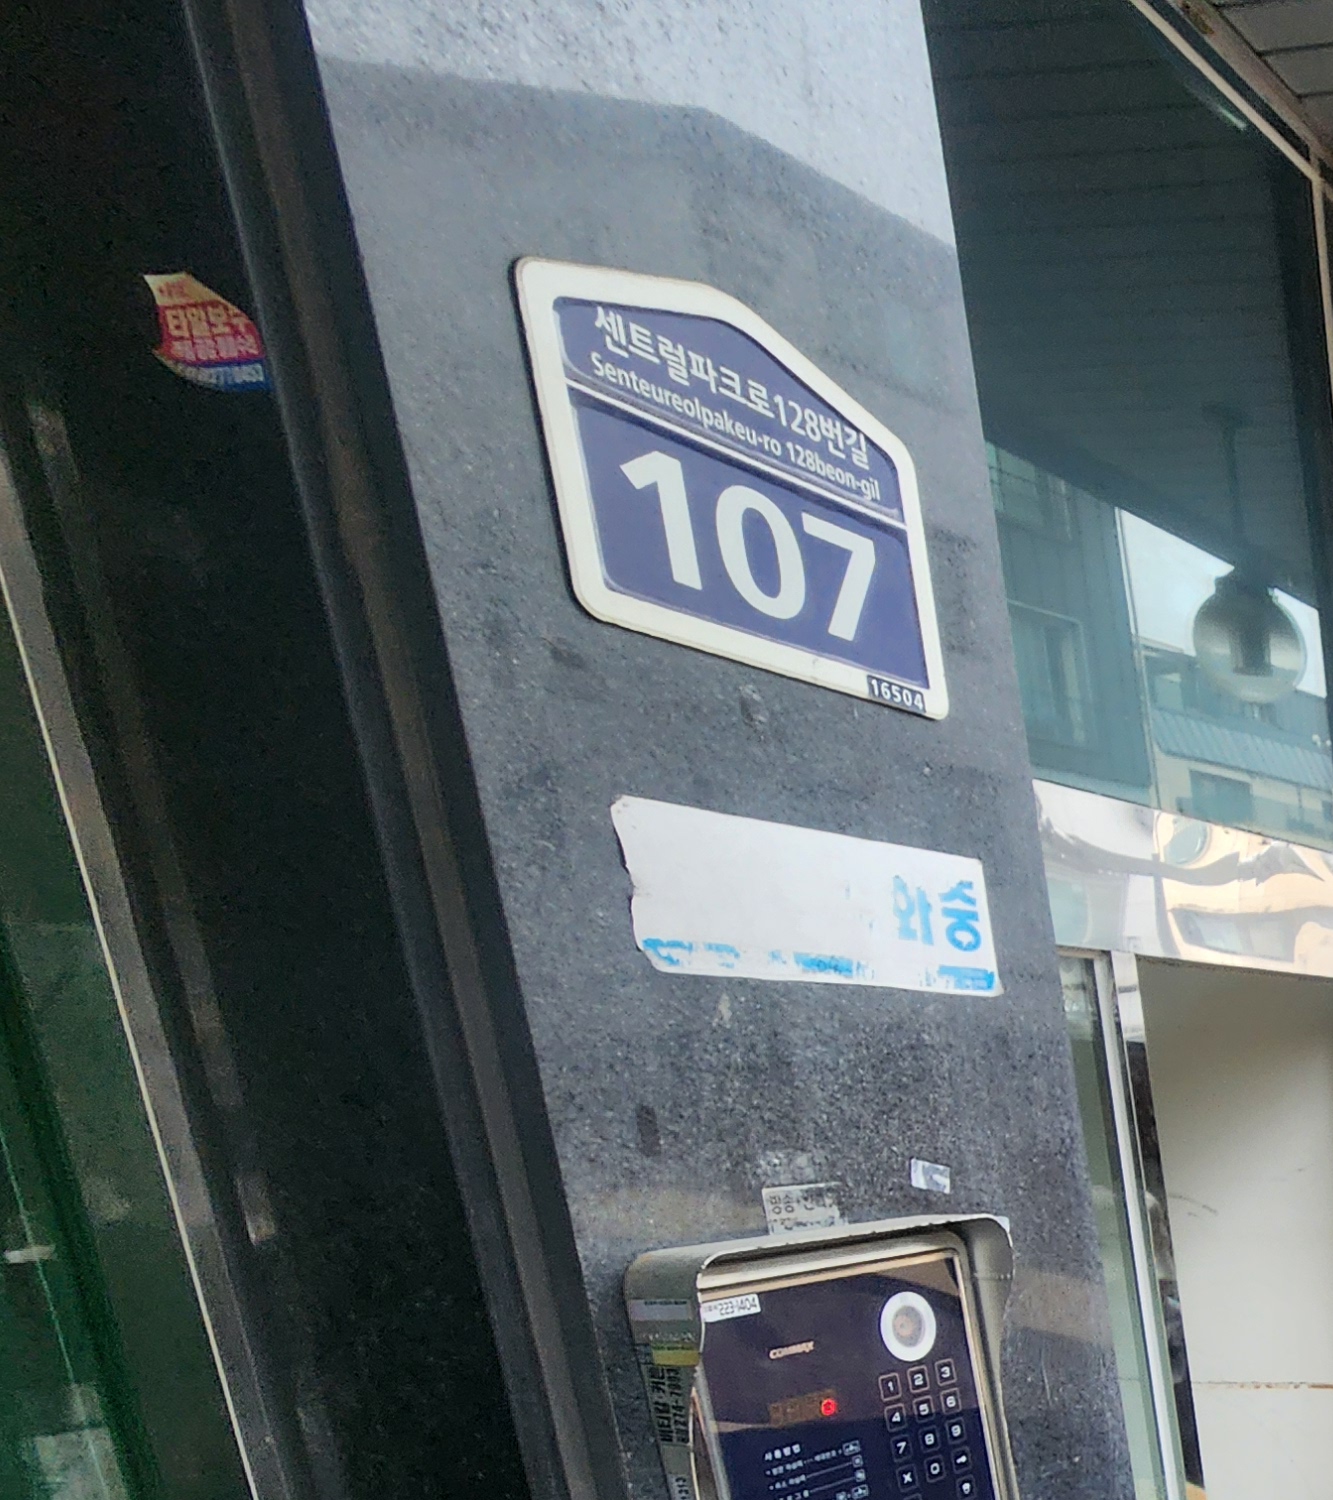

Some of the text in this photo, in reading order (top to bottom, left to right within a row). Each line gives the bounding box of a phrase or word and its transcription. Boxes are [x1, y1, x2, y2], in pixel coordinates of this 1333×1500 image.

[594, 305, 871, 471] 센트럴파크로128번길
[590, 351, 881, 501] Senteureolpakeu-ro 128beon-gil
[619, 450, 876, 642] 107
[870, 677, 925, 712] 16504
[886, 1365, 952, 1393] 1 2 3
[891, 1394, 957, 1423] 4 5 6
[896, 1424, 962, 1455] 7 8 9
[930, 1462, 941, 1475] 0
